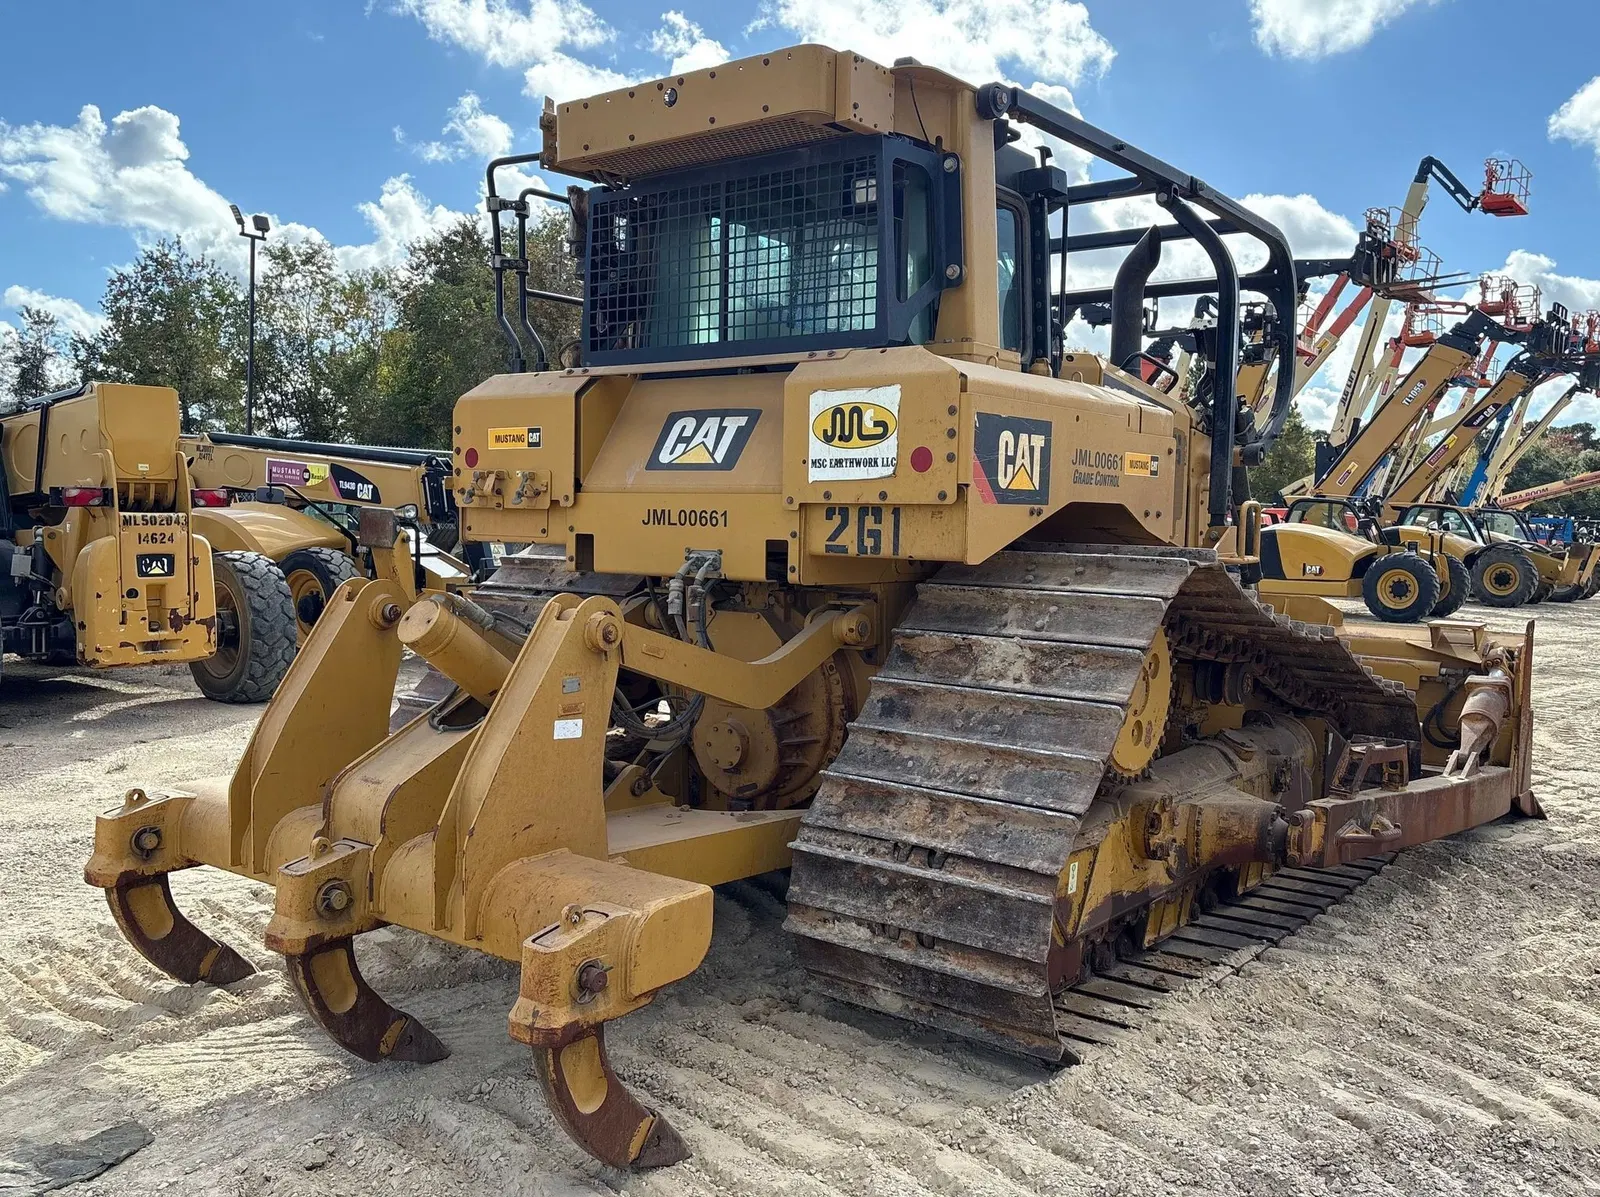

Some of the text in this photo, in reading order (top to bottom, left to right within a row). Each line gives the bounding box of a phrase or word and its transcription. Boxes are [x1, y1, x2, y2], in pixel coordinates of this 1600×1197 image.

[1340, 368, 1356, 407] JLG LIFT
[1402, 382, 1424, 406] TL1055
[1483, 405, 1496, 418] CAT
[495, 432, 540, 444] MUSTANG CAT
[659, 416, 749, 464] CAT
[811, 456, 897, 468] MSC EARTHWORK LLC
[997, 430, 1045, 491] CAT
[1071, 448, 1123, 471] JML00661
[1129, 460, 1149, 471] MUSTANG
[272, 466, 301, 476] MUSTANG
[1073, 469, 1120, 488] GRADE CONTROL
[357, 482, 373, 500] CAT
[122, 514, 188, 526] ML502043
[642, 508, 728, 528] JML00661
[138, 532, 175, 545] 14624
[825, 506, 901, 556] 2G1
[142, 557, 168, 574] CAT
[1306, 565, 1320, 574] CAT
